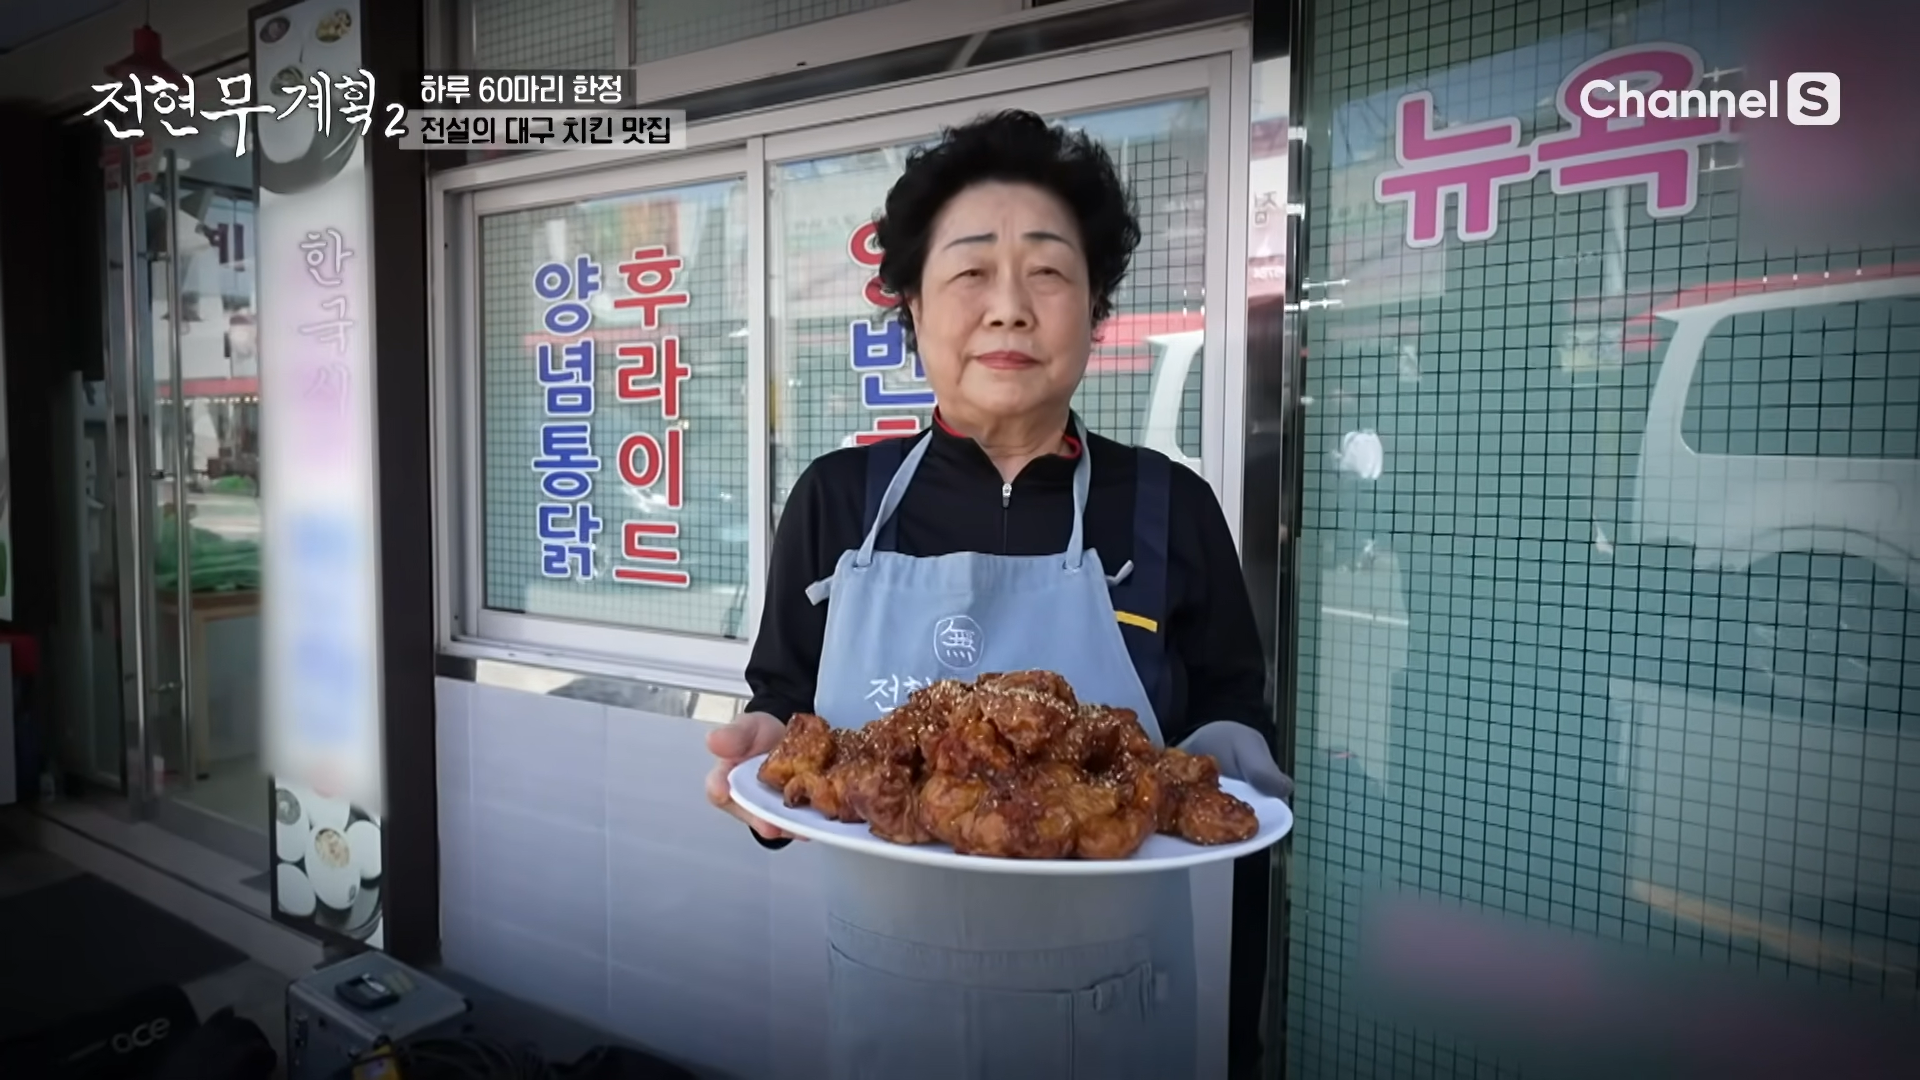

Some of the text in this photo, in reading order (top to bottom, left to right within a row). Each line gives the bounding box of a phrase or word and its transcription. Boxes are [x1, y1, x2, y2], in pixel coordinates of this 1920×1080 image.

[1375, 42, 1728, 248] 뉴욕
[532, 254, 602, 579] 양념통닭
[613, 245, 690, 589] 후라이드
